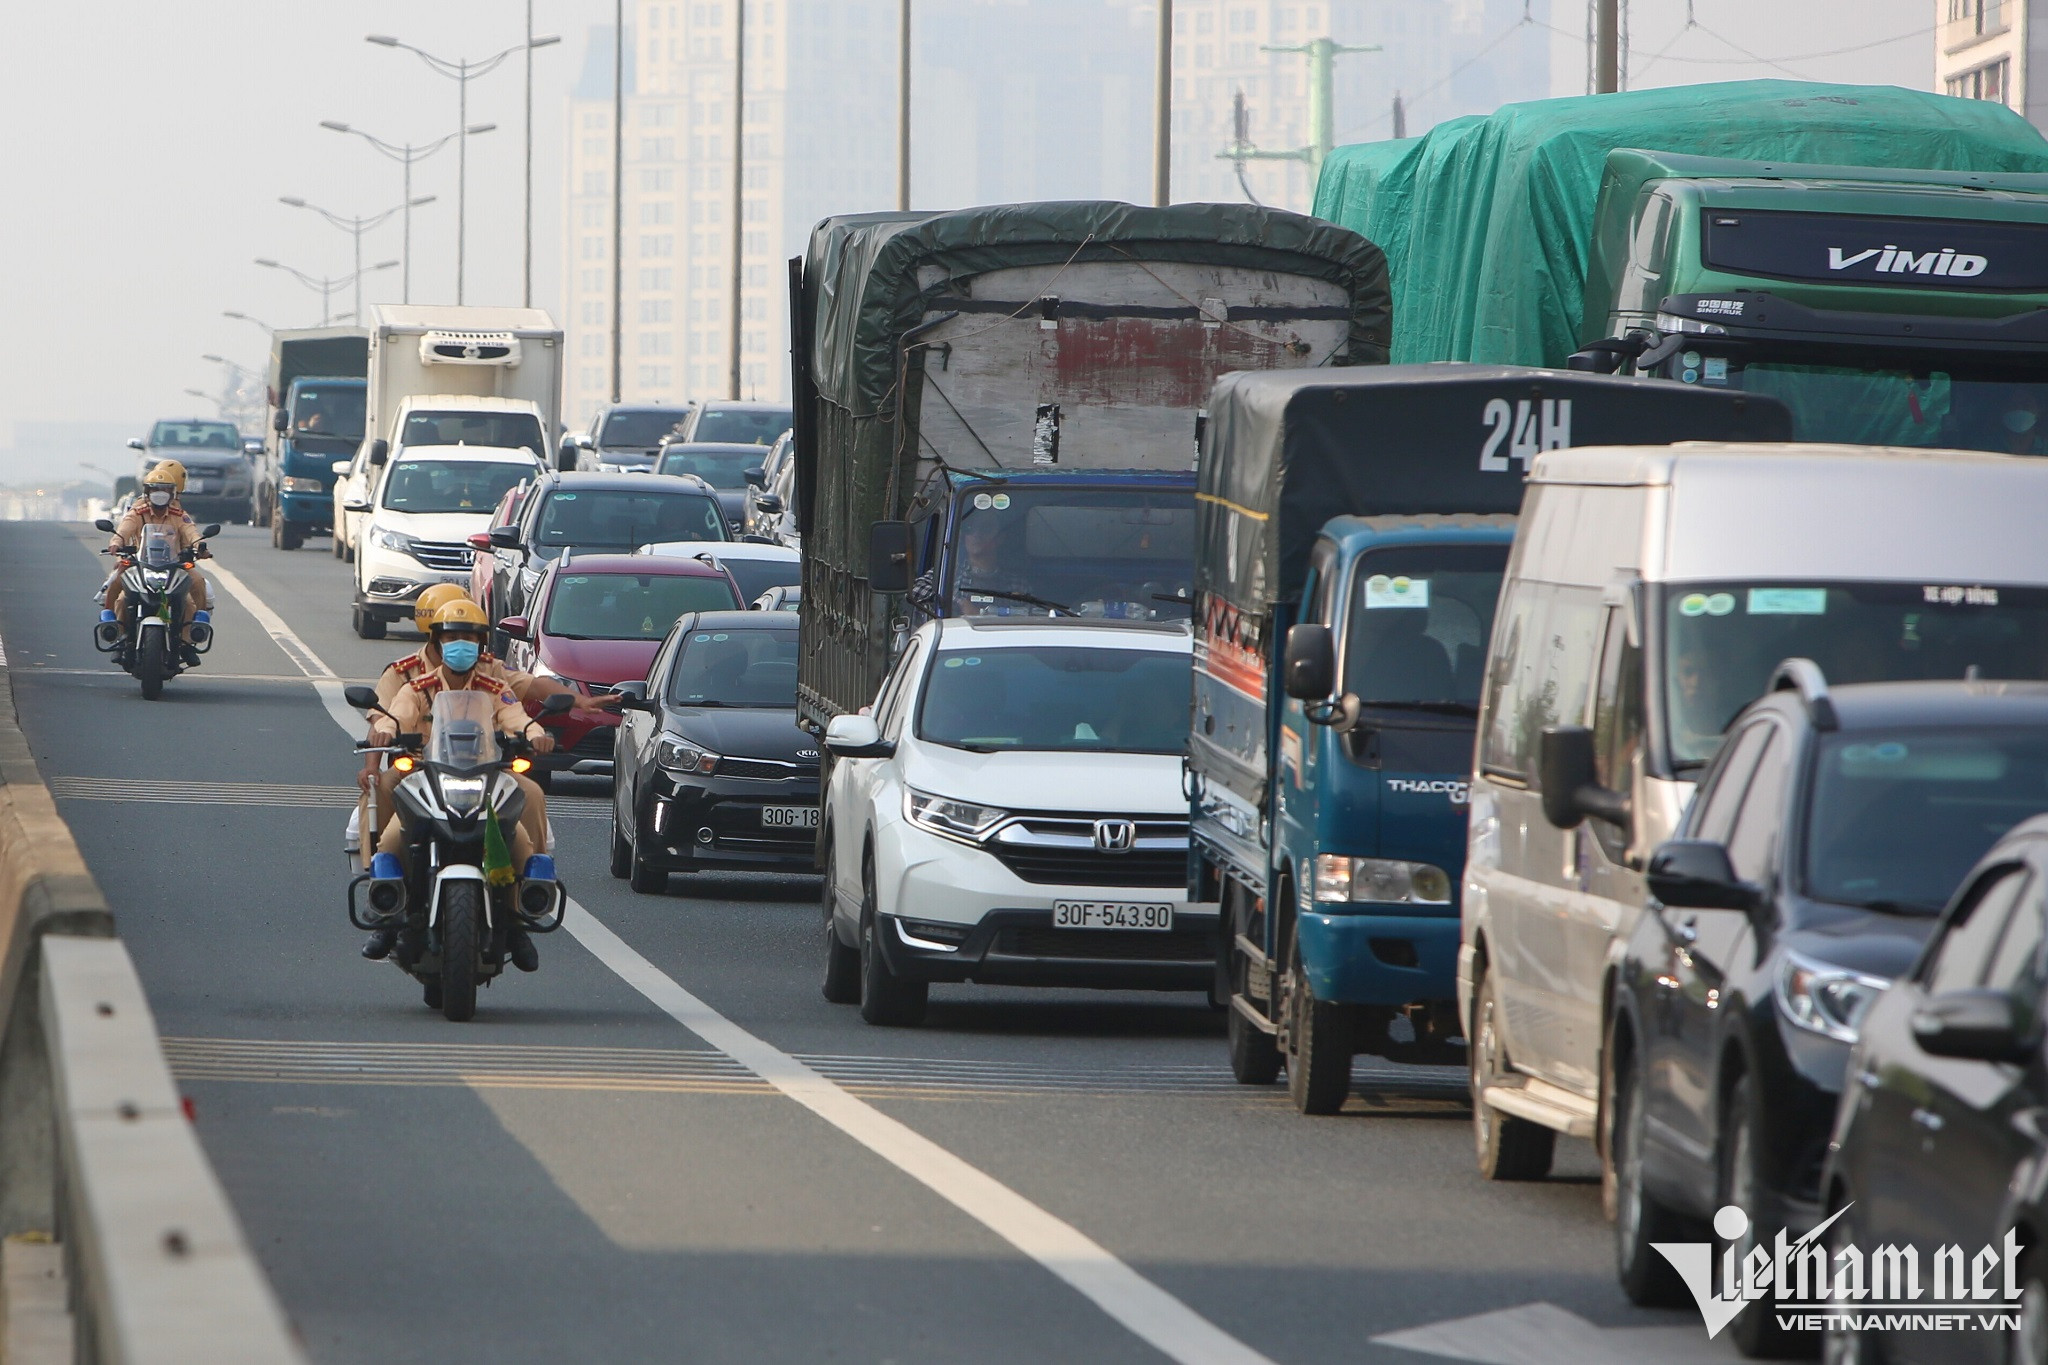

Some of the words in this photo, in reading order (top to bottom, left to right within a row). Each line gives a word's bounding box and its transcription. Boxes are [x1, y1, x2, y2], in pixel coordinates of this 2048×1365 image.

[1696, 307, 1742, 316] SINOTRUK
[1480, 398, 1572, 472] 24H
[799, 749, 820, 758] KIA
[1386, 779, 1460, 793] THACO
[764, 808, 820, 826] 30G-18
[1057, 903, 1170, 928] 30F-543.90
